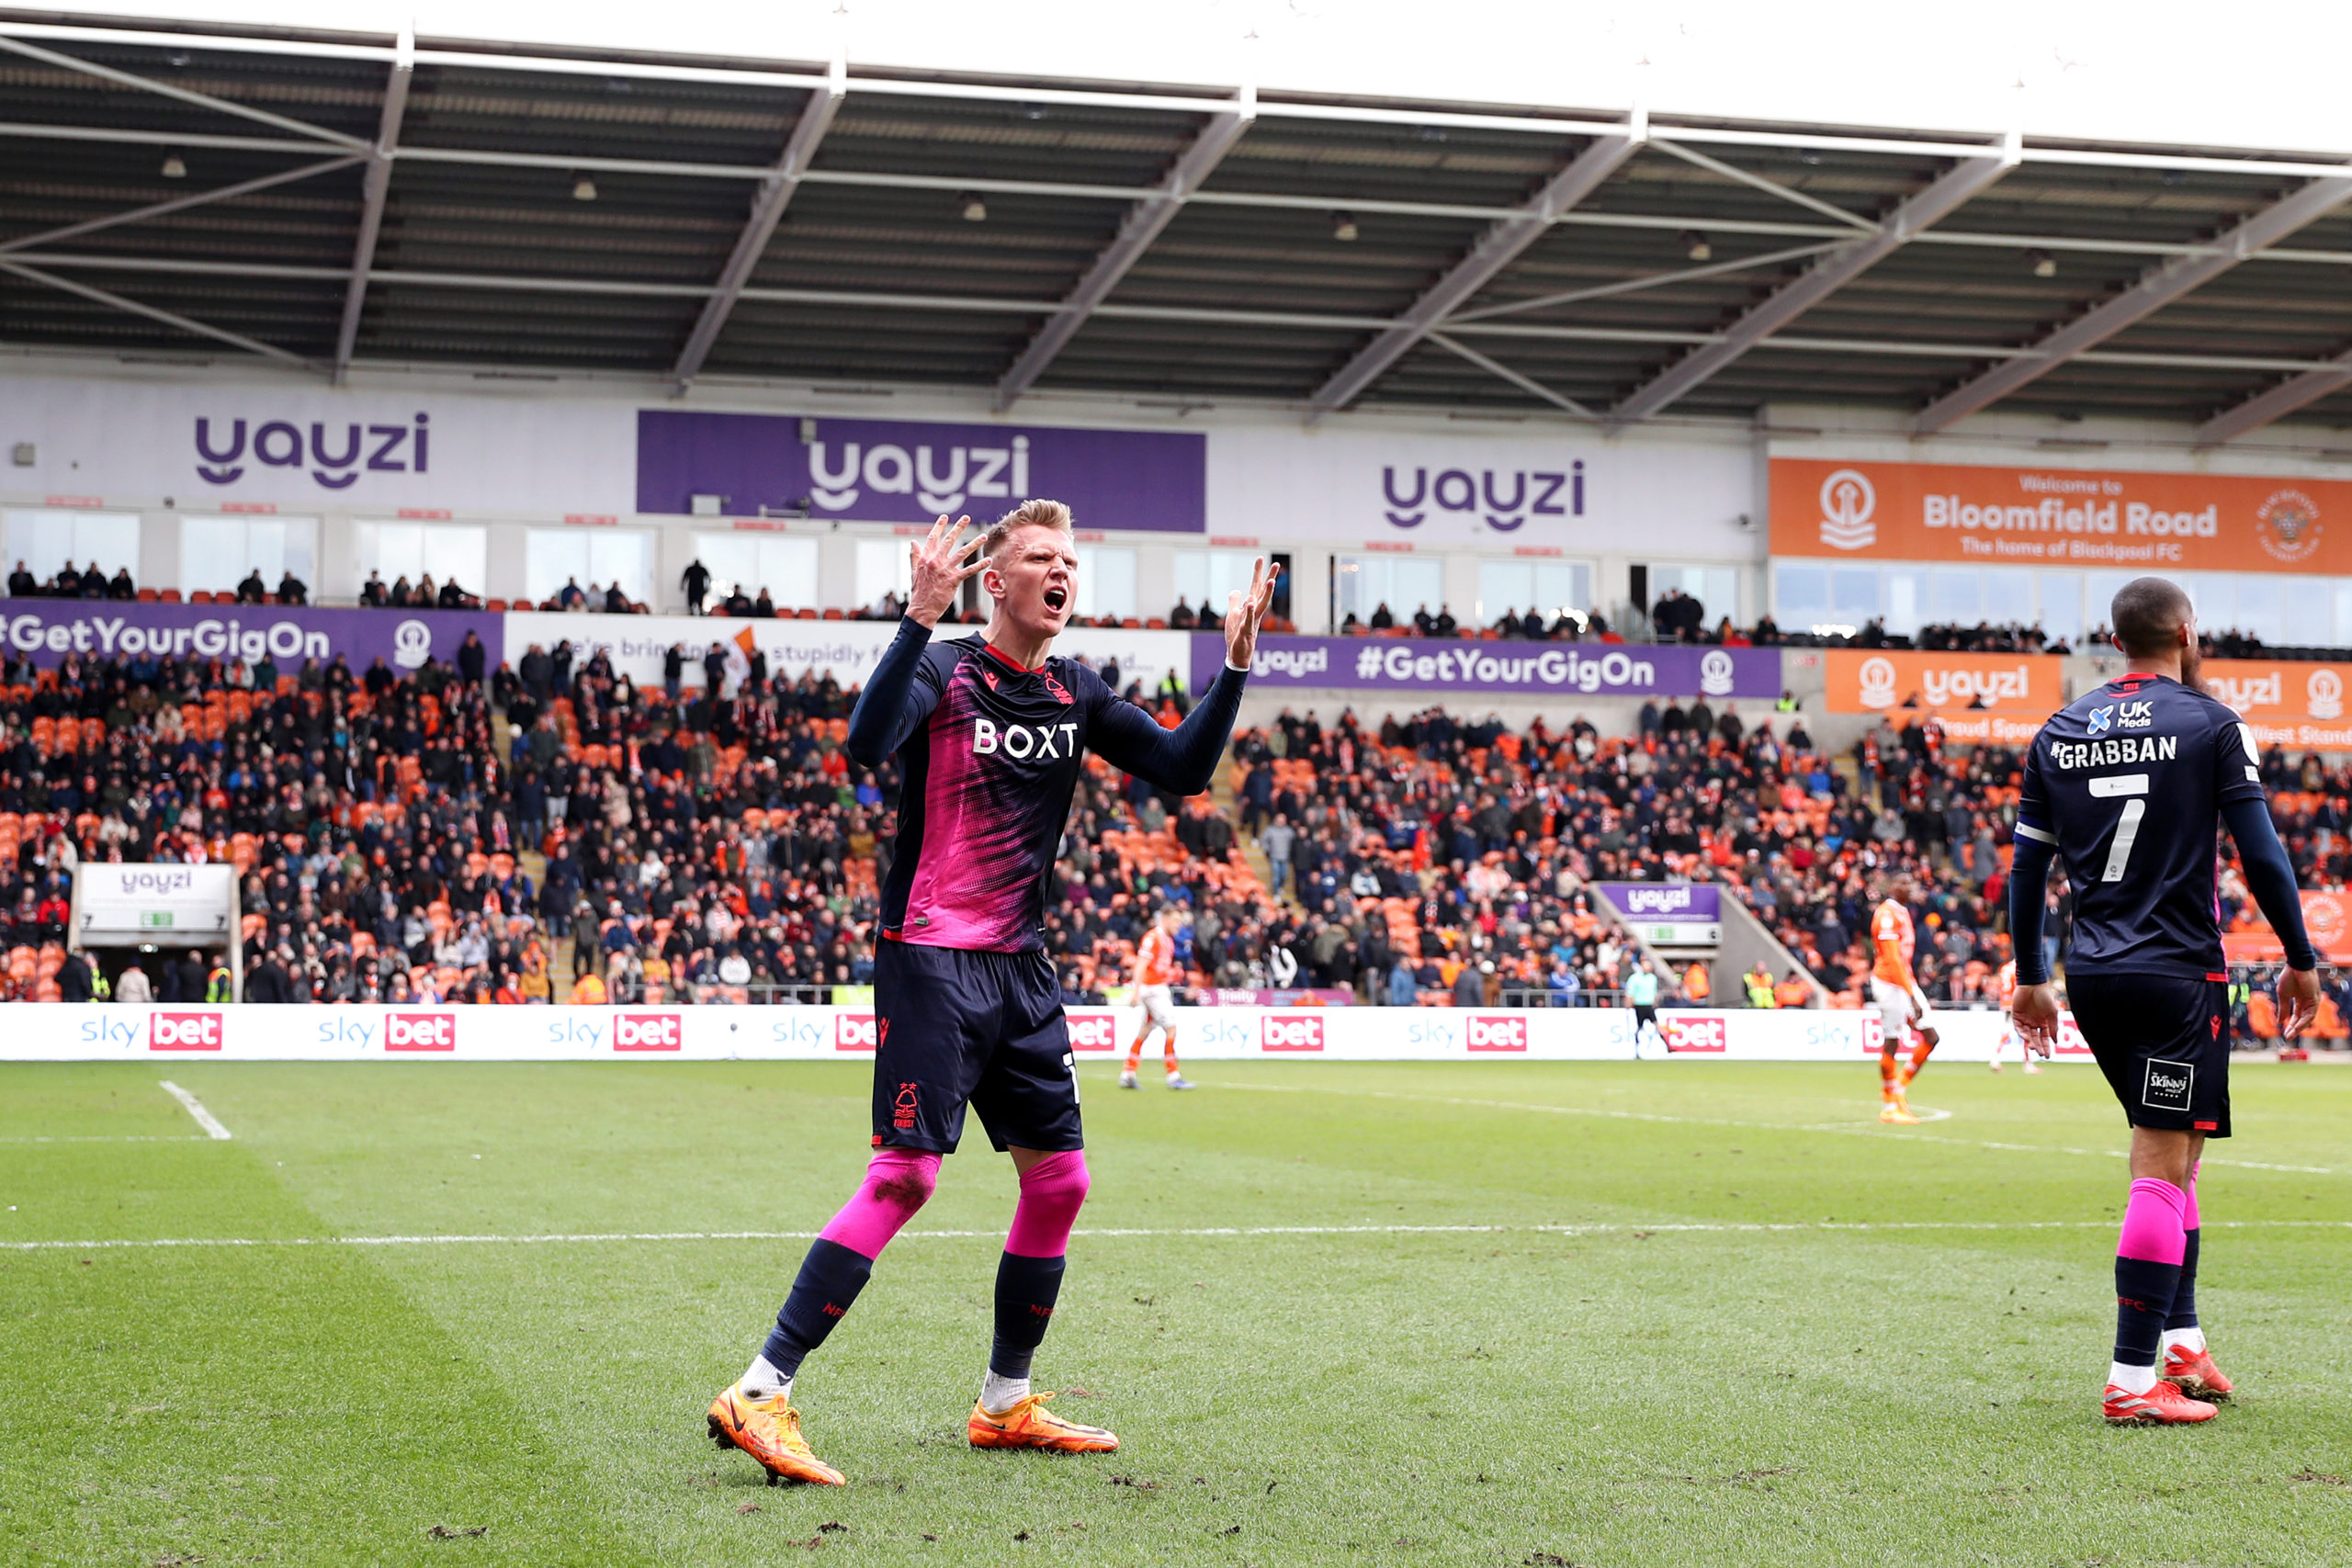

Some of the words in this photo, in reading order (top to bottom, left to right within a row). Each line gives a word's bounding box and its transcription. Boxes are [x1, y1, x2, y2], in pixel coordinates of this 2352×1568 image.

[196, 412, 429, 489] yayzi
[809, 434, 1029, 514] yayzi
[2019, 475, 2099, 493] Welcome
[2102, 480, 2122, 495] to
[1384, 459, 1584, 531] yayzi
[1924, 494, 2118, 533] Bloomfield
[2126, 502, 2217, 536] Road
[1961, 536, 1992, 555] The
[1996, 537, 2043, 556] home
[2047, 540, 2066, 557] of
[2070, 540, 2153, 562] Blackpool
[2156, 544, 2183, 561] FC
[0, 615, 329, 665] GetYourGigOn
[774, 643, 865, 668] stupidly
[1252, 647, 1328, 678] yayzi
[1356, 646, 1654, 692] #GetYourGigOn
[1923, 665, 2028, 706] yayzi
[2117, 717, 2151, 728] Meds
[2119, 701, 2153, 717] UK
[973, 718, 1079, 759] BOXT
[1992, 718, 2042, 742] Spon
[2059, 737, 2177, 770] GRABBAN
[2088, 773, 2149, 882] 7
[121, 871, 191, 894] yayzi
[1628, 886, 1690, 912] yayzi
[81, 1014, 140, 1048] sky
[154, 1013, 217, 1045] bet
[319, 1016, 375, 1048] sky
[389, 1013, 450, 1045] bet
[549, 1017, 604, 1048] sky
[616, 1014, 678, 1045] bet
[773, 1016, 825, 1047] sky
[839, 1015, 876, 1045] be
[1203, 1019, 1250, 1049] sky
[1263, 1017, 1320, 1046] bet
[1409, 1020, 1457, 1049] sky
[1469, 1018, 1524, 1046] bet
[1668, 1018, 1723, 1047] bet
[1807, 1021, 1851, 1049] sky
